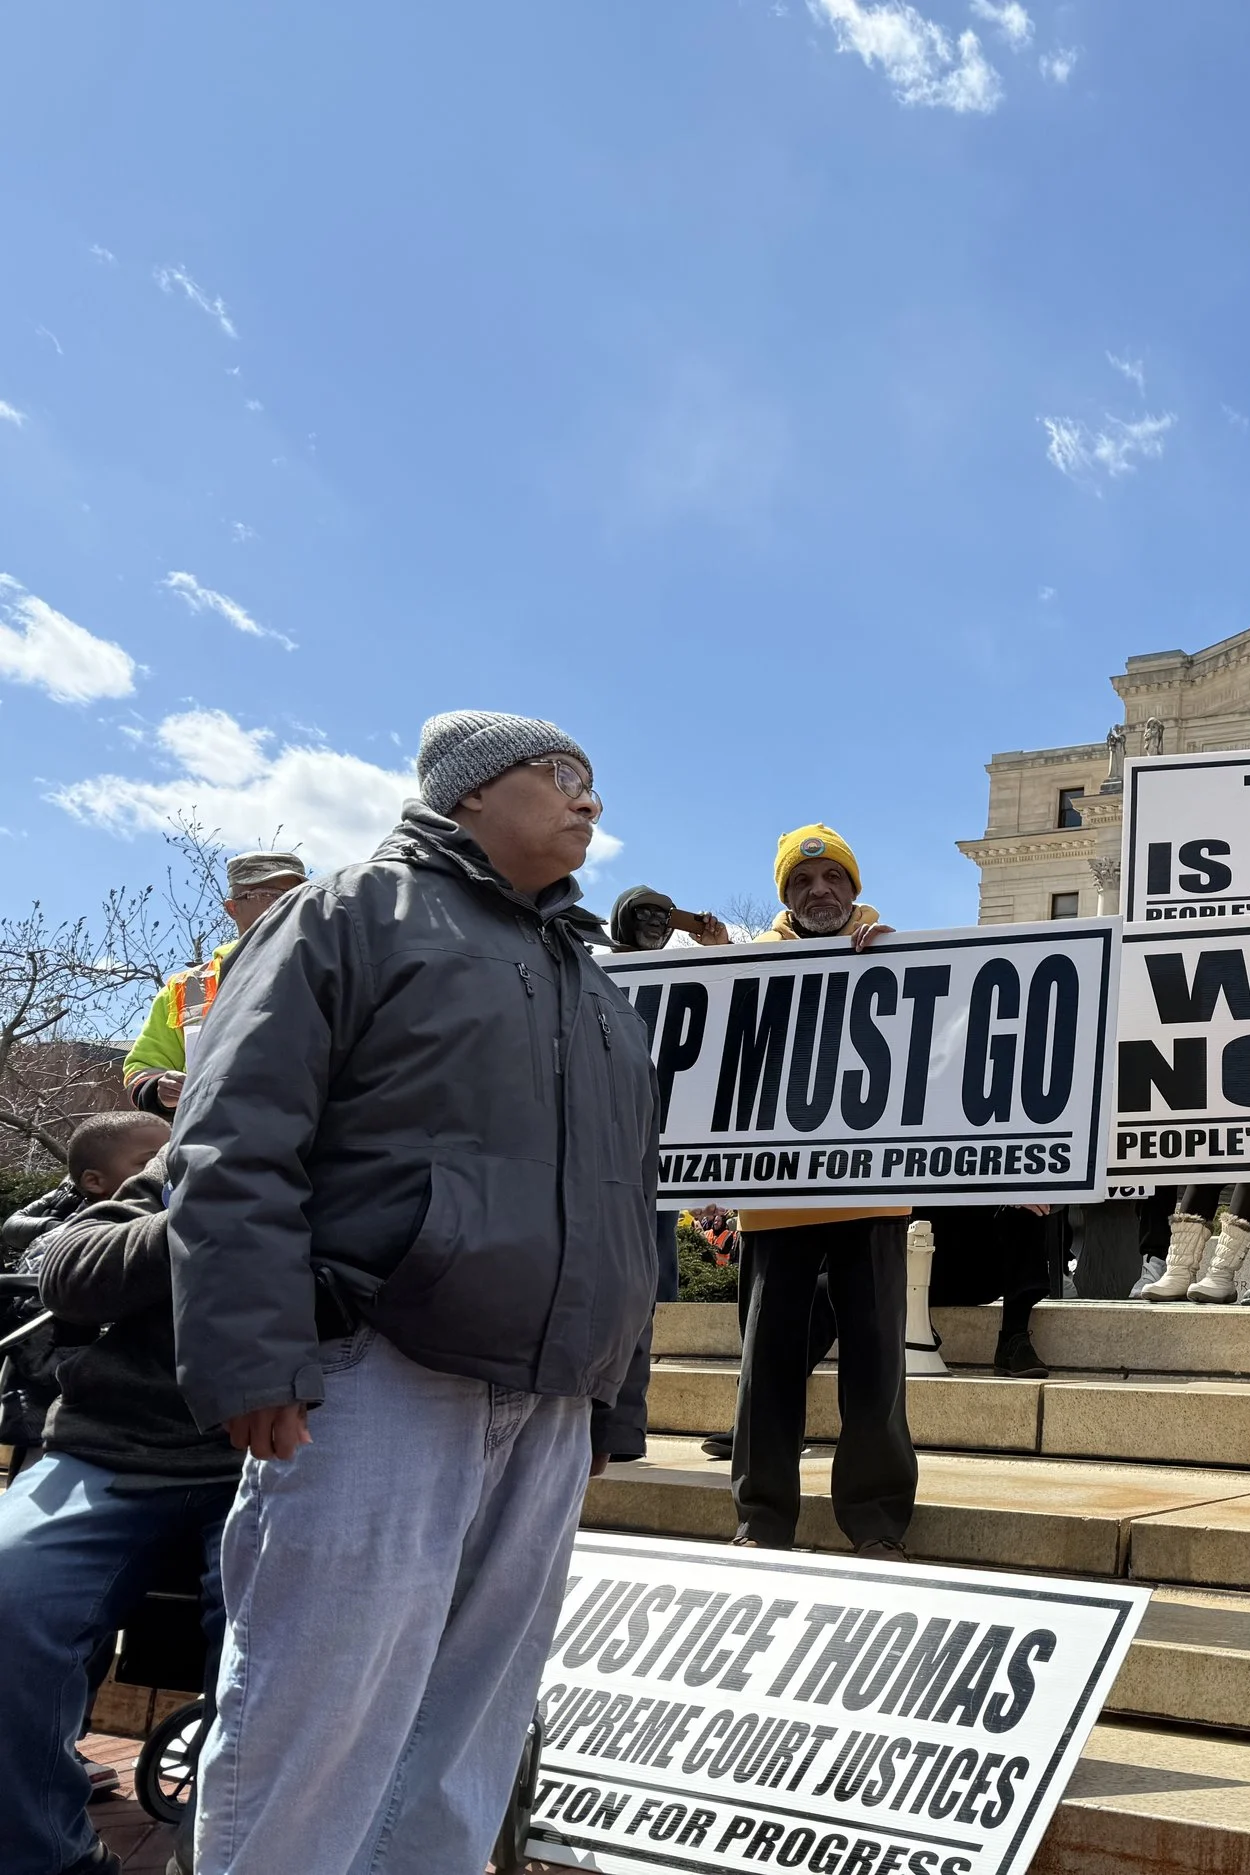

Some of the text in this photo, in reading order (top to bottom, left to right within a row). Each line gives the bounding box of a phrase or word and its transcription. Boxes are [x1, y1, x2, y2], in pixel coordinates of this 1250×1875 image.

[1148, 838, 1232, 895] IS
[711, 965, 952, 1133] MUST
[961, 953, 1080, 1127] GO
[808, 1148, 873, 1180] FOR
[883, 1143, 1071, 1177] PROGRESS
[548, 1579, 1057, 1733] JUSTICE THOMAS
[538, 1683, 1030, 1829] SUPREME COURT JUSTICES
[624, 1798, 718, 1848] FOR
